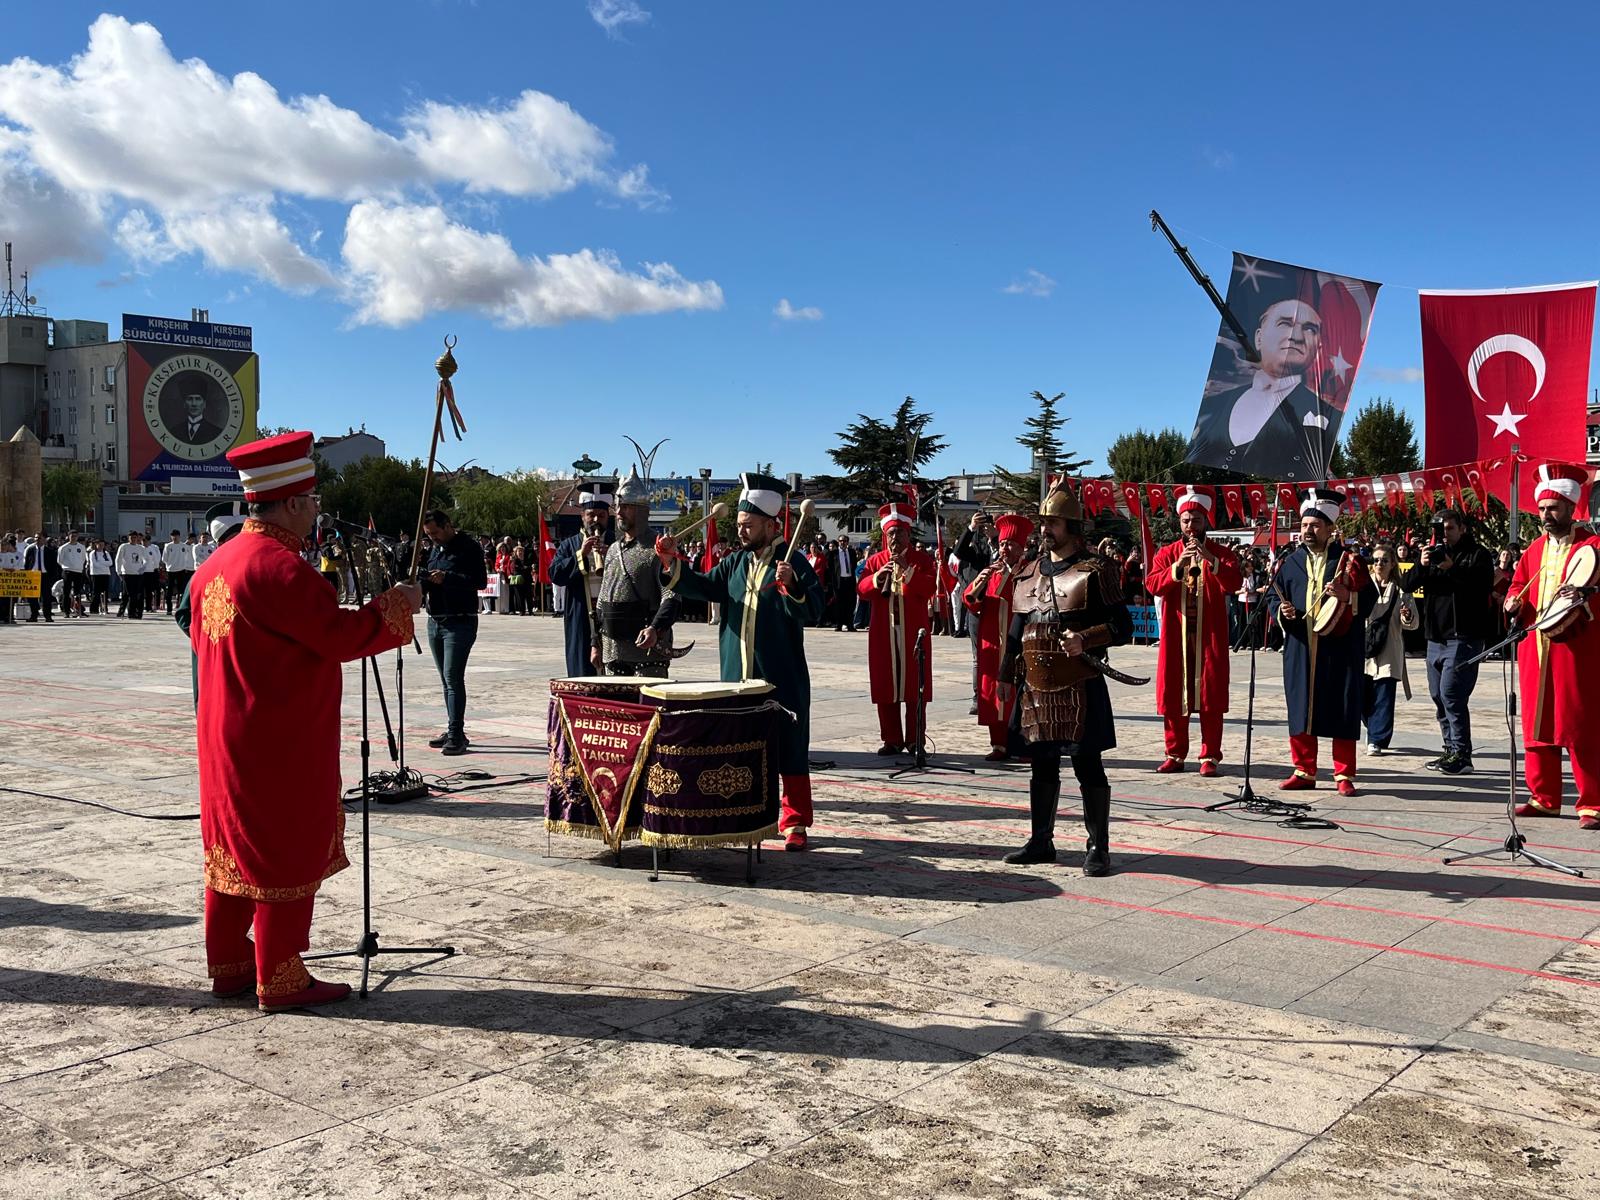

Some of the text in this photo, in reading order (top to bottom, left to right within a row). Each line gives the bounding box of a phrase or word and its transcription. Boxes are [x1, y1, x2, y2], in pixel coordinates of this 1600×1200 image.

[124, 327, 212, 346] SÜRÜCÜ KURSU
[147, 355, 201, 398] KIRŞEHİR
[150, 419, 238, 458] OKULLARI
[574, 718, 642, 737] BELEDİYESİ
[581, 733, 628, 750] MEHTER
[582, 748, 627, 764] TAKIMI
